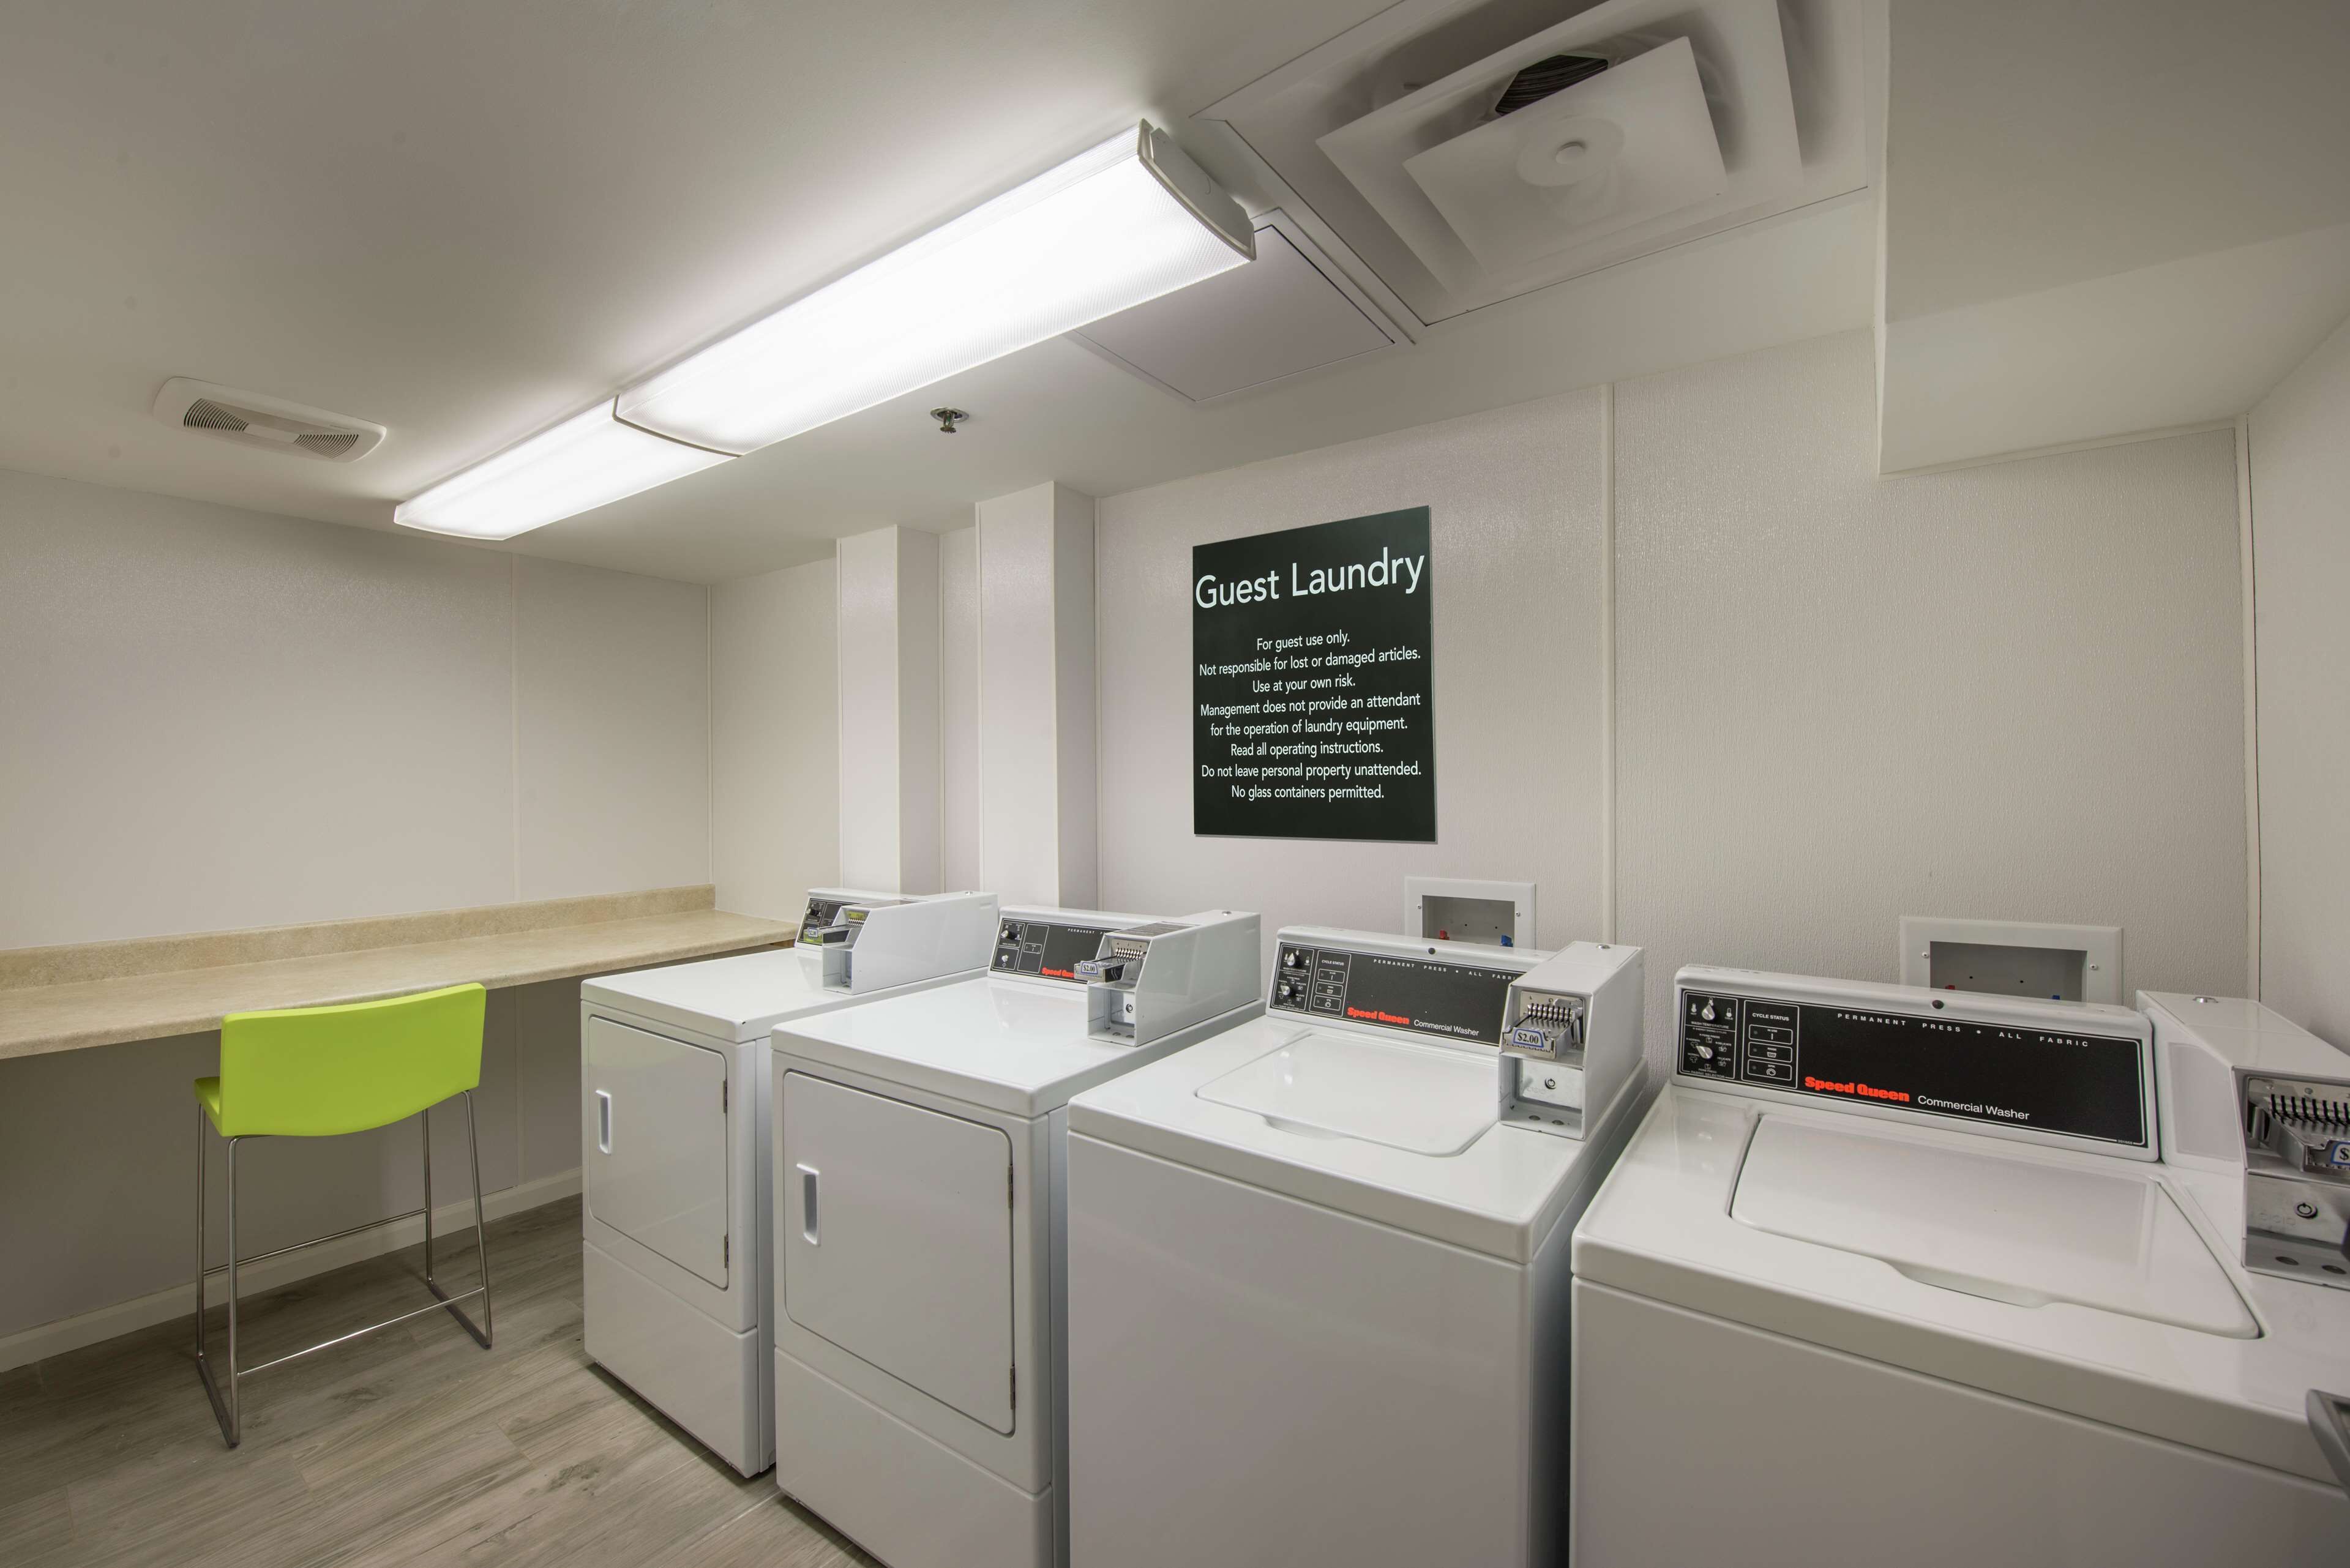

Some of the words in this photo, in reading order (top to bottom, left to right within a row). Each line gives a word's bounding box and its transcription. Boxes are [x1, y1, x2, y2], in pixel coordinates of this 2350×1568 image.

[1196, 570, 1279, 608] Guest
[1292, 546, 1425, 597] Laundry
[1257, 638, 1273, 651] For
[1275, 635, 1303, 653] guest
[1306, 635, 1323, 646] use
[1326, 629, 1350, 647] only.
[1199, 663, 1217, 676] Not
[1219, 657, 1271, 678] responsible
[1273, 656, 1288, 670] for
[1290, 655, 1309, 669] lost
[1311, 657, 1323, 667] or
[1325, 648, 1375, 668] damaged
[1378, 645, 1421, 662] articles.
[1252, 679, 1271, 693] Use
[1273, 680, 1283, 692] at
[1285, 680, 1308, 695] your
[1310, 678, 1332, 689] own
[1334, 672, 1356, 687] risk.
[1200, 702, 1260, 719] Management
[1262, 699, 1287, 714] does
[1289, 700, 1306, 712] not
[1308, 695, 1348, 715] provide
[1350, 698, 1363, 709] an
[1366, 691, 1421, 708] attendant
[1210, 723, 1224, 736] for
[1225, 722, 1241, 736] the
[1243, 721, 1289, 739] operation
[1292, 719, 1303, 733] of
[1305, 717, 1343, 736] laundry
[1345, 717, 1408, 735] equipment.
[1230, 742, 1254, 756] Read
[1256, 742, 1267, 756] all
[1270, 741, 1317, 760] operating
[1320, 739, 1383, 755] instructions.
[1202, 764, 1215, 777] Do
[1217, 766, 1233, 777] not
[1235, 763, 1259, 777] leave
[1262, 762, 1303, 781] personal
[1306, 764, 1352, 781] property
[1354, 760, 1421, 776] unattended.
[1231, 785, 1246, 798] No
[1248, 783, 1272, 802] glass
[1274, 785, 1326, 798] containers
[1328, 783, 1385, 803] permitted.
[1062, 969, 1074, 978] Que
[1374, 958, 1415, 968] PERMANENT
[1347, 1007, 1377, 1020] Speed
[1378, 1012, 1410, 1025] Queen
[1413, 1019, 1453, 1032] Commercial
[1453, 1026, 1480, 1036] Washer
[1838, 1013, 1906, 1026] PERMANENT
[1922, 1023, 1961, 1032] PRESS
[2039, 1036, 2089, 1047] FABRIC
[1517, 1032, 1538, 1044] $2.00
[1805, 1076, 1855, 1094] Speed
[1857, 1083, 1910, 1102] Queen
[1917, 1095, 1983, 1113] Commercial
[1985, 1105, 2030, 1121] Washer
